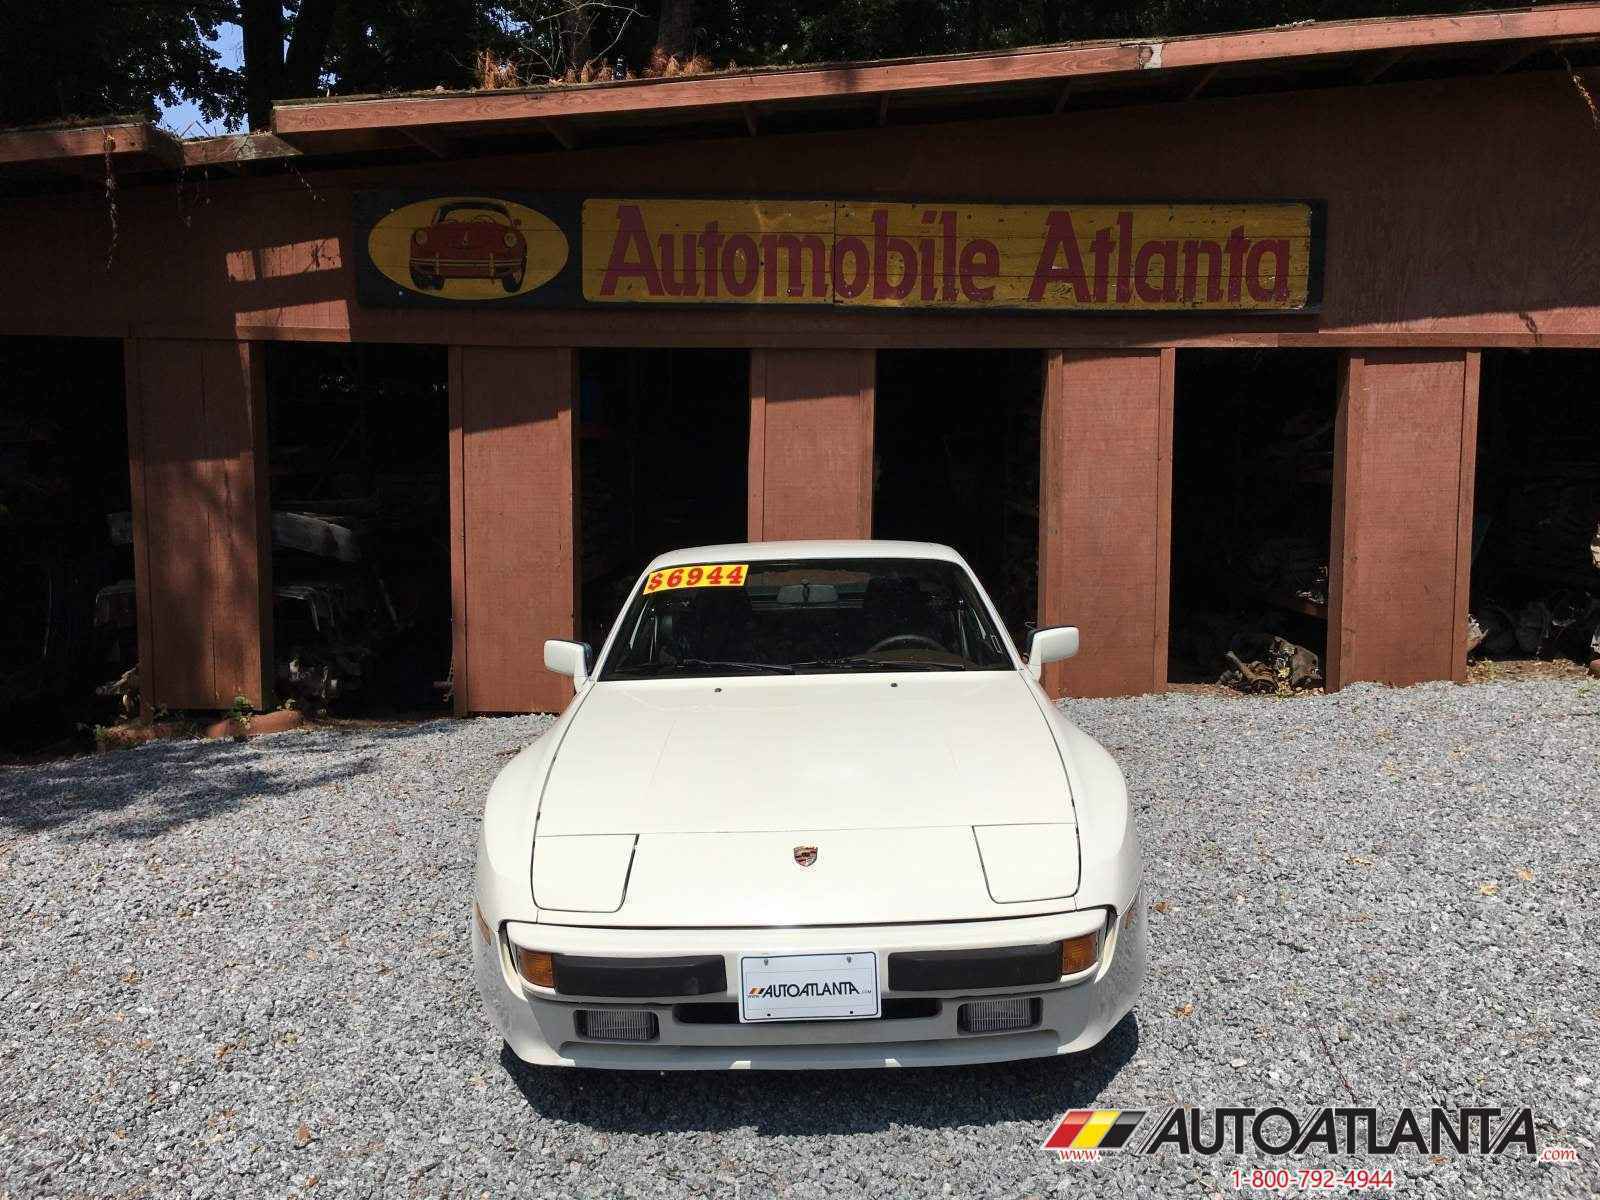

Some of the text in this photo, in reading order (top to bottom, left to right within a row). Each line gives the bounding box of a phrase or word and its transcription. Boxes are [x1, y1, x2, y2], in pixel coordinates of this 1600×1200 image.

[601, 204, 1290, 303] Automobile Atlanta
[647, 566, 743, 590] $6944
[762, 981, 860, 998] AUTOATLANTA
